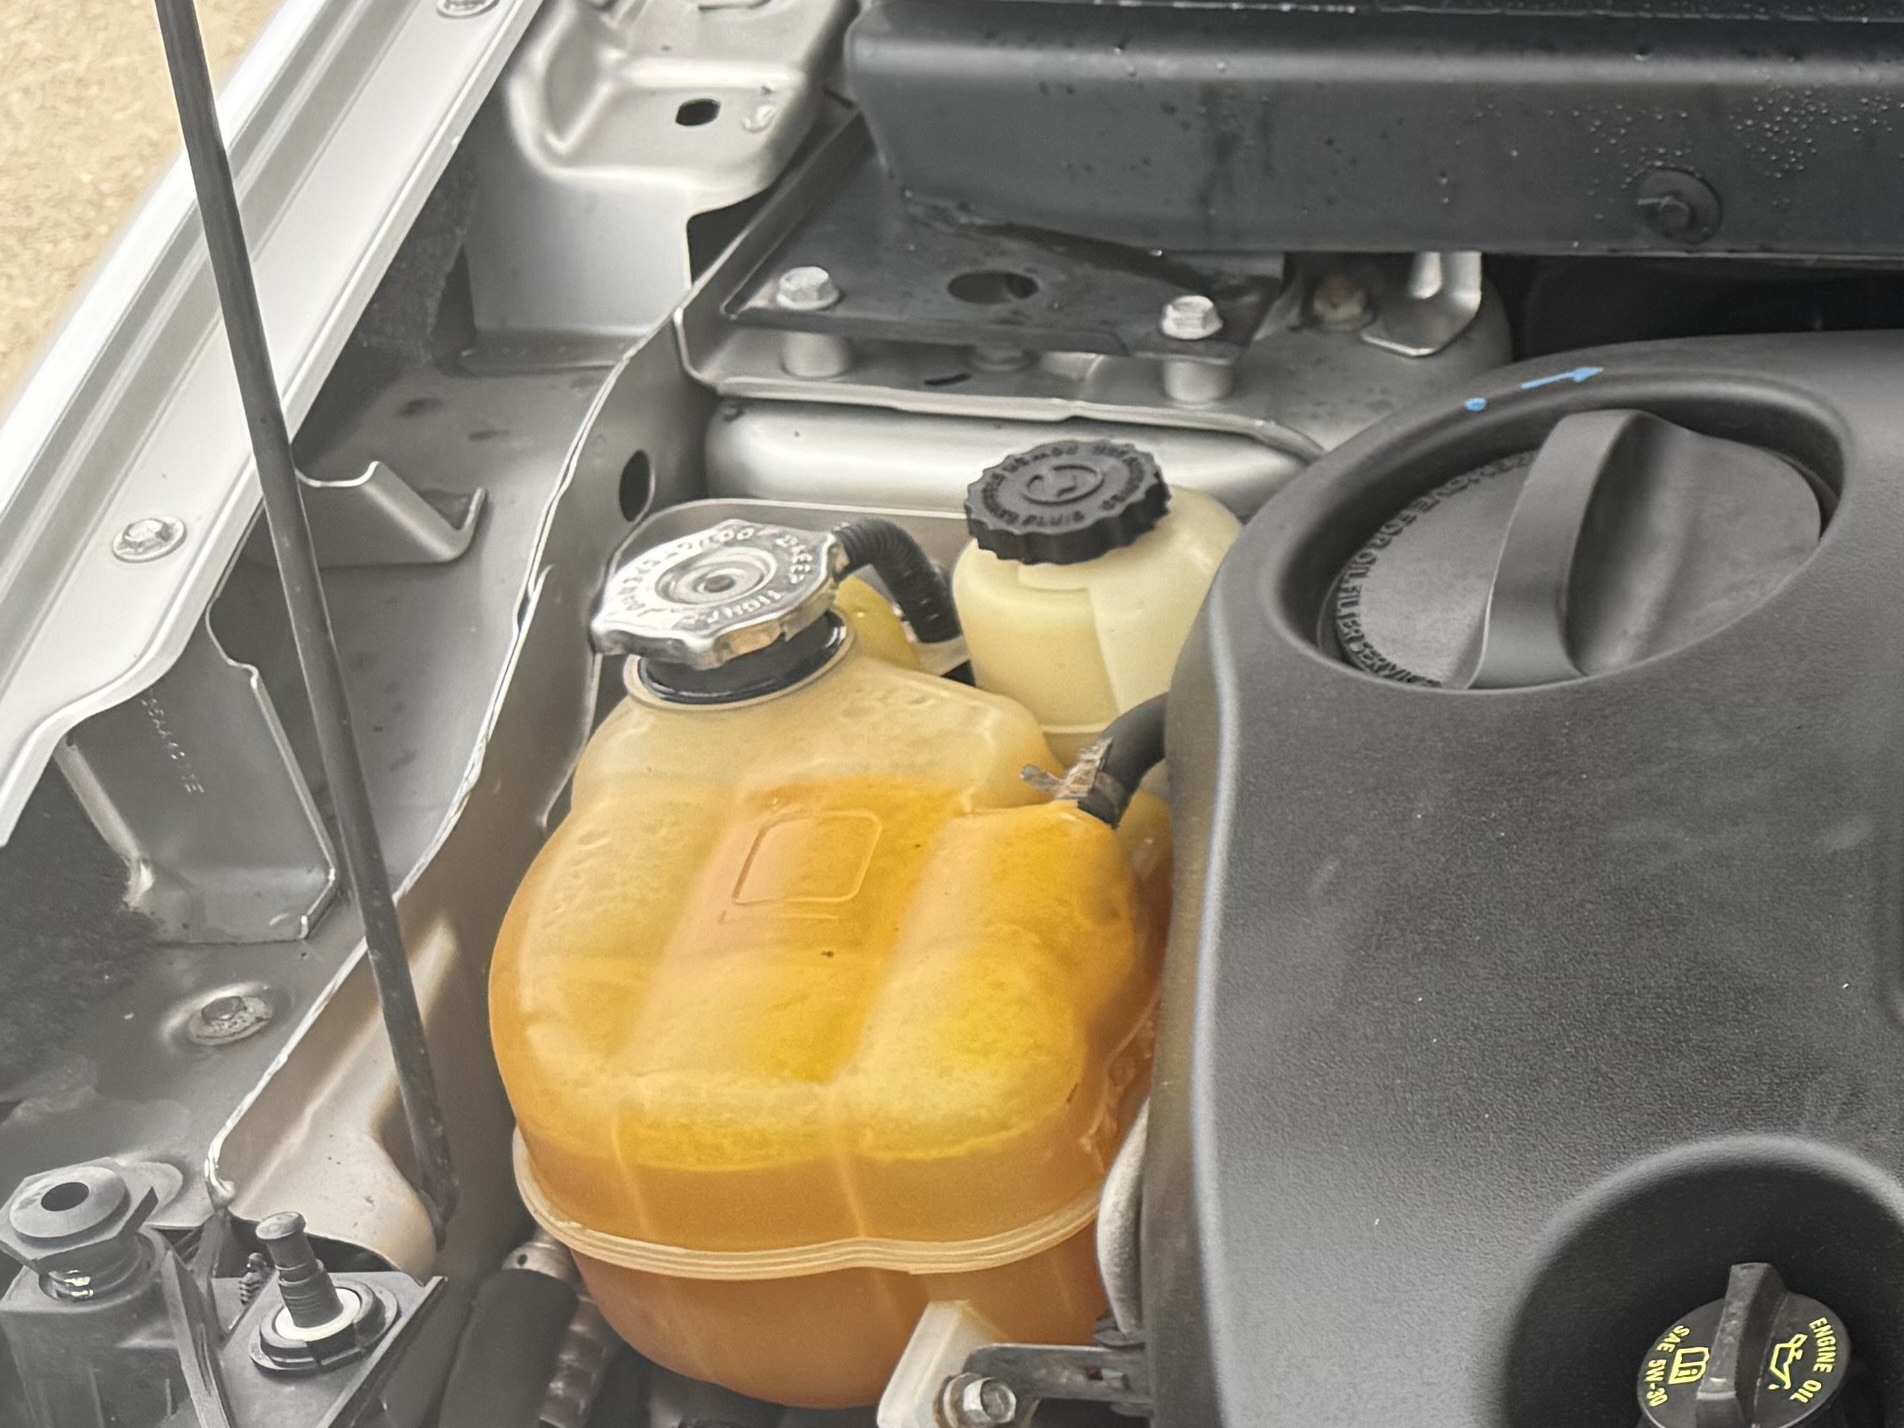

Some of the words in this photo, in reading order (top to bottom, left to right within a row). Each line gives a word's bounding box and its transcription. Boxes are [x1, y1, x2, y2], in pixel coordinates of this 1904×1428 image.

[1367, 508, 1418, 550] FOR
[1344, 550, 1378, 585] OIL
[1336, 582, 1367, 644] FILTER
[1656, 1323, 1691, 1354] SAE
[1808, 1315, 1837, 1375] ENGINE
[1643, 1358, 1669, 1409] 5W-30
[1788, 1378, 1823, 1405] OIL
